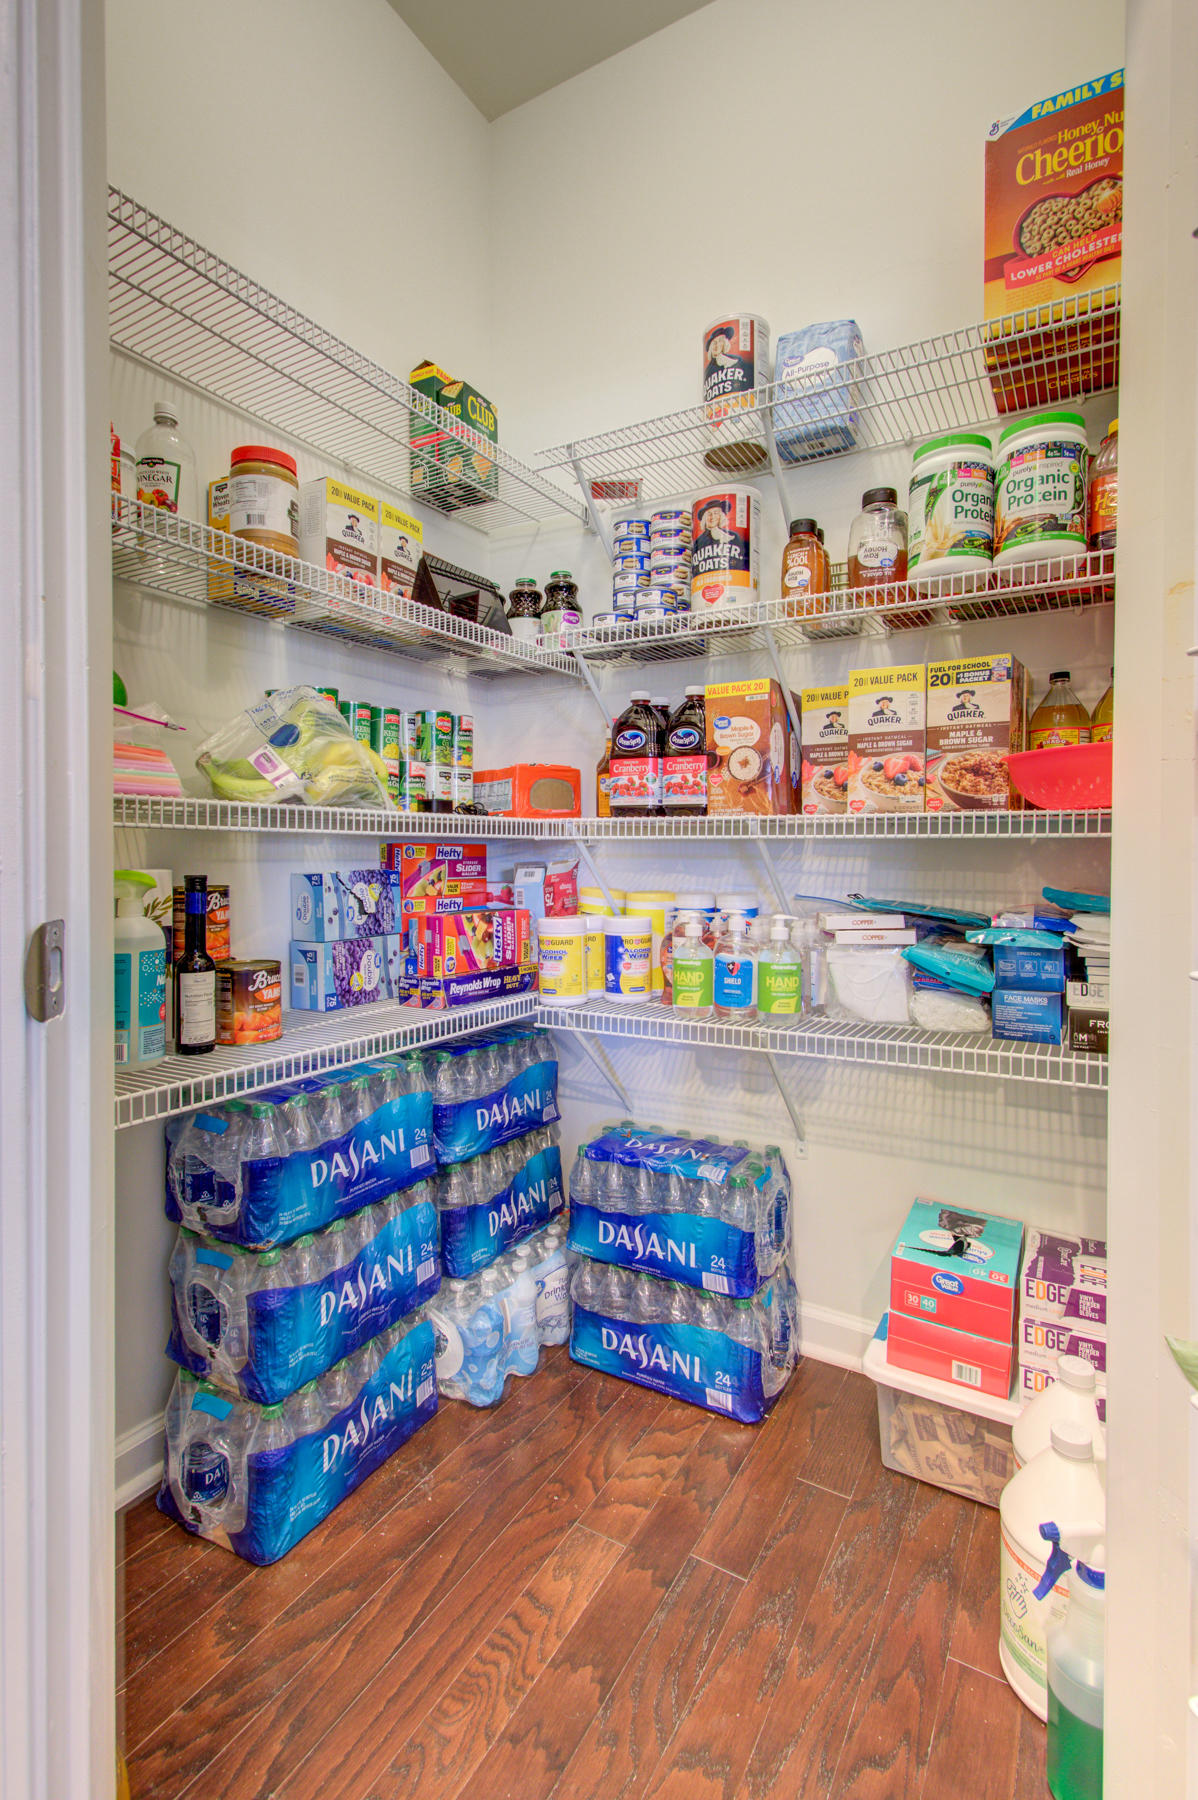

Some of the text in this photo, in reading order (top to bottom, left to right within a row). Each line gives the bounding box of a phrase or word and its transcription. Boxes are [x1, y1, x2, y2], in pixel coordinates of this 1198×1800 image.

[1031, 78, 1105, 119] FAMILY
[1058, 120, 1100, 144] Honey
[1016, 128, 1124, 185] Cheerio
[1066, 157, 1110, 178] Real Honey
[1052, 234, 1096, 258] CAN HELP
[1010, 259, 1053, 281] LOWER
[785, 361, 830, 378] All-Purpose
[706, 381, 732, 401] OATS
[468, 396, 494, 431] CLUB
[1006, 469, 1070, 494] Organic
[331, 486, 375, 512] 20 VALUE PACK
[385, 510, 420, 534] 20 VALUE PACK
[342, 530, 365, 544] QUAKER
[394, 550, 412, 562] QUAKER
[692, 544, 741, 566] QUAKER
[699, 558, 728, 572] OATS
[963, 662, 991, 670] SCHOOL
[854, 672, 918, 687] 20 VALUE PACK
[930, 673, 950, 687] 20
[707, 682, 764, 696] VALUE PACK 20
[806, 694, 815, 702] 20
[821, 692, 841, 700] VALUE
[868, 716, 901, 726] QUAKER
[947, 711, 984, 720] QUAKER
[819, 729, 848, 738] QUAKER
[949, 730, 975, 738] MAPLE
[968, 736, 994, 744] SUGAR
[613, 764, 649, 773] Cranberry
[666, 762, 704, 771] Cranberry
[437, 847, 461, 859] Hefty
[456, 864, 481, 872] SLIDER
[437, 900, 461, 910] Hefty
[494, 919, 502, 960] Hefty
[504, 975, 521, 984] HEAVY
[674, 971, 704, 983] HAND
[766, 976, 799, 987] HAND
[449, 977, 501, 995] Reynolds Wrap
[1073, 984, 1104, 997] EDGE
[476, 1088, 540, 1131] DASANI
[310, 1128, 427, 1188] DASANI 24
[625, 1138, 709, 1161] DASANI
[489, 1179, 546, 1237] DASANI
[598, 1220, 726, 1269] DASANI 24
[320, 1241, 433, 1327] DASANI 24
[936, 1275, 959, 1288] Great
[1026, 1278, 1067, 1305] EDGE
[908, 1294, 934, 1307] 30 40
[1024, 1324, 1066, 1352] EDGE
[601, 1327, 731, 1387] DASANI 24
[1024, 1368, 1055, 1392] ED
[322, 1358, 433, 1474] DASANI 24
